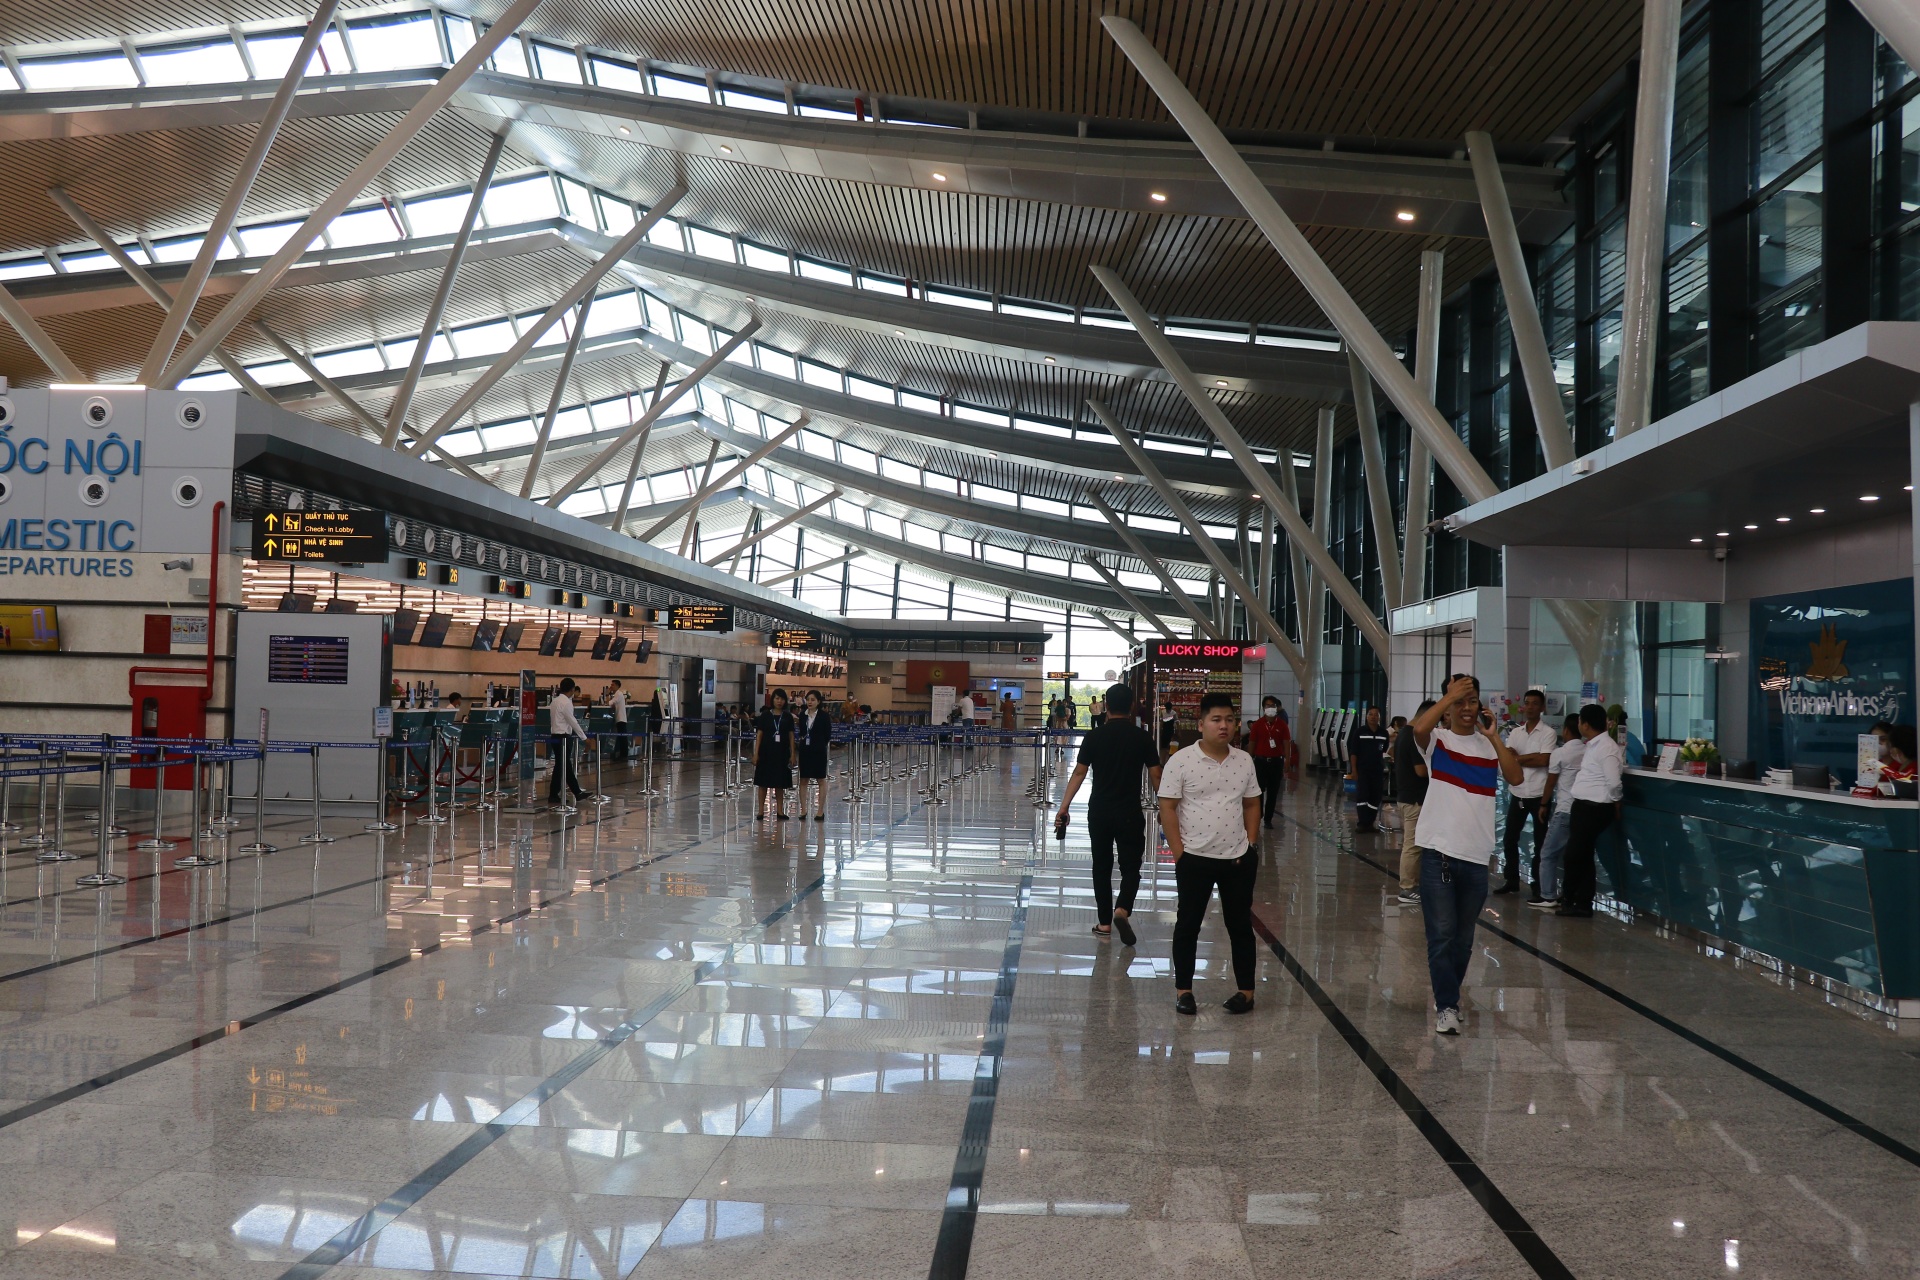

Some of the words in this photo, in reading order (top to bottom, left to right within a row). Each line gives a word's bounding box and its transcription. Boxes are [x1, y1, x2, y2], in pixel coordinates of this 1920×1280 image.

[64, 432, 142, 483] NỘI
[335, 526, 354, 534] Lobby
[418, 561, 427, 577] 25
[450, 568, 458, 583] 26
[500, 579, 507, 592] 27
[1159, 645, 1200, 655] LUCKY
[1203, 645, 1239, 656] SHOP
